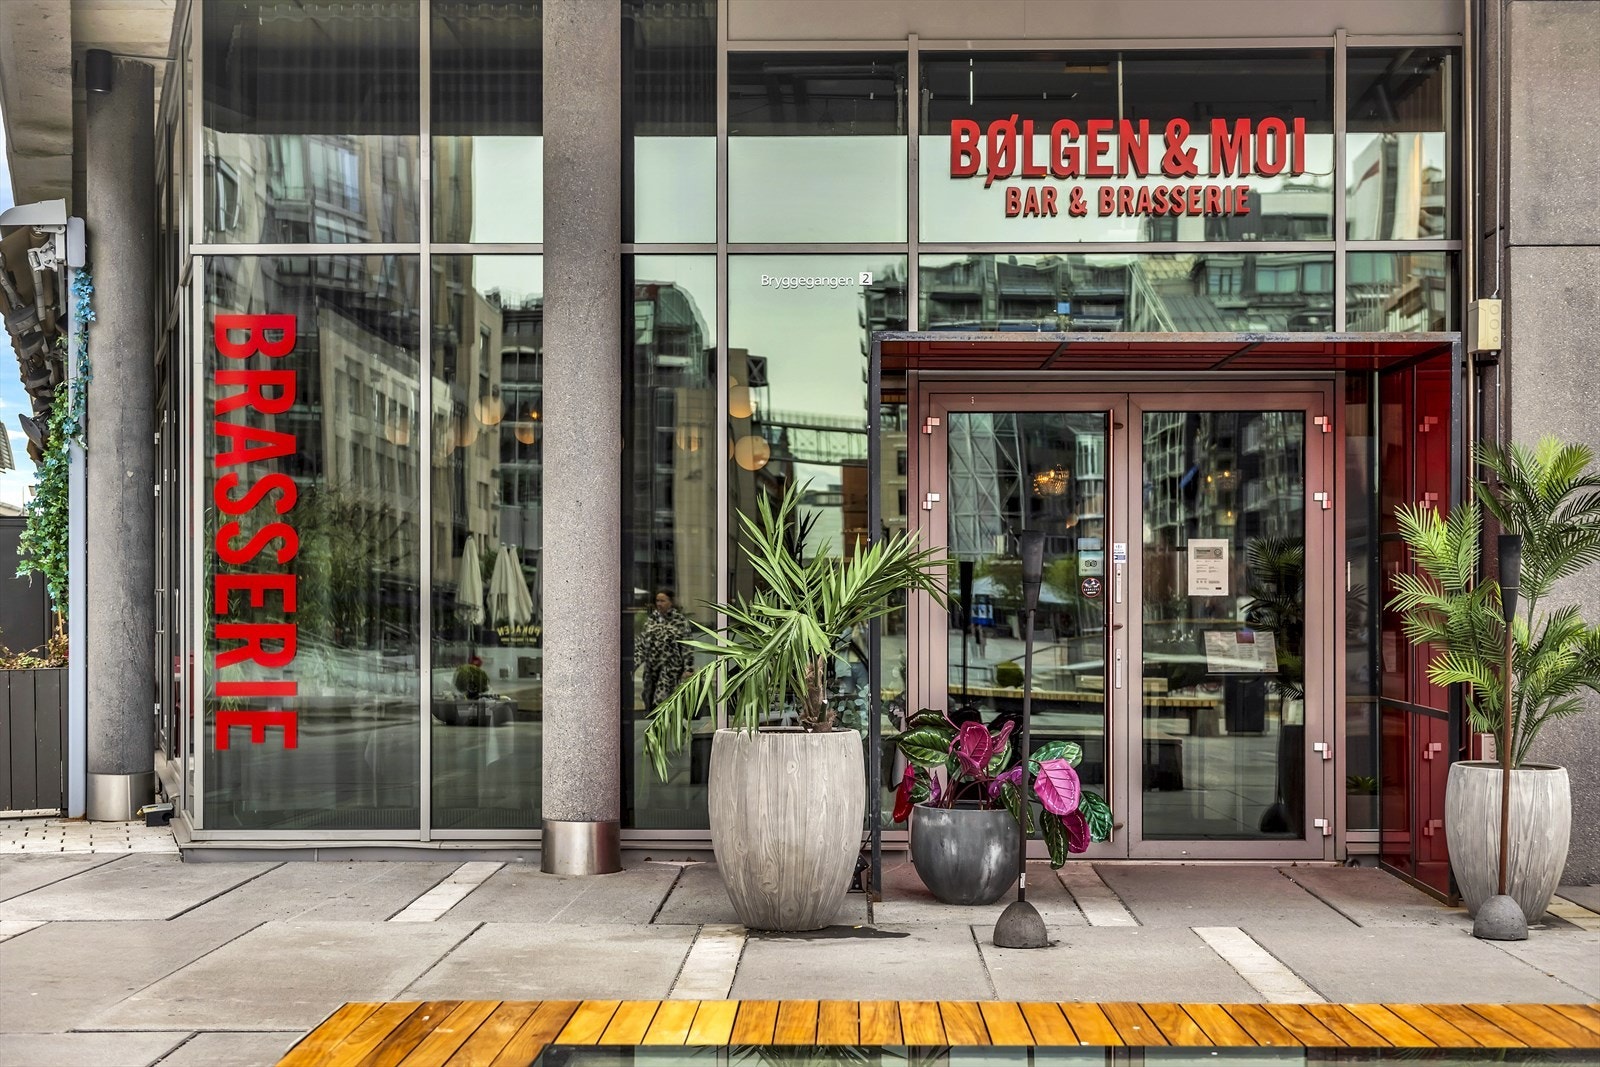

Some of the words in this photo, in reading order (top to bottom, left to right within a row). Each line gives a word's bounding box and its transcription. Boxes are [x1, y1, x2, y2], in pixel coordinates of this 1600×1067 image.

[950, 114, 1149, 188] BØLGEN
[1162, 117, 1198, 179] &
[1209, 117, 1305, 179] MOI
[1005, 186, 1058, 217] BAR
[1069, 186, 1088, 217] &
[1099, 185, 1251, 217] BRASSERIE
[761, 274, 854, 289] Bryggegangen
[861, 273, 871, 285] 2
[213, 313, 298, 752] BRASSERIE
